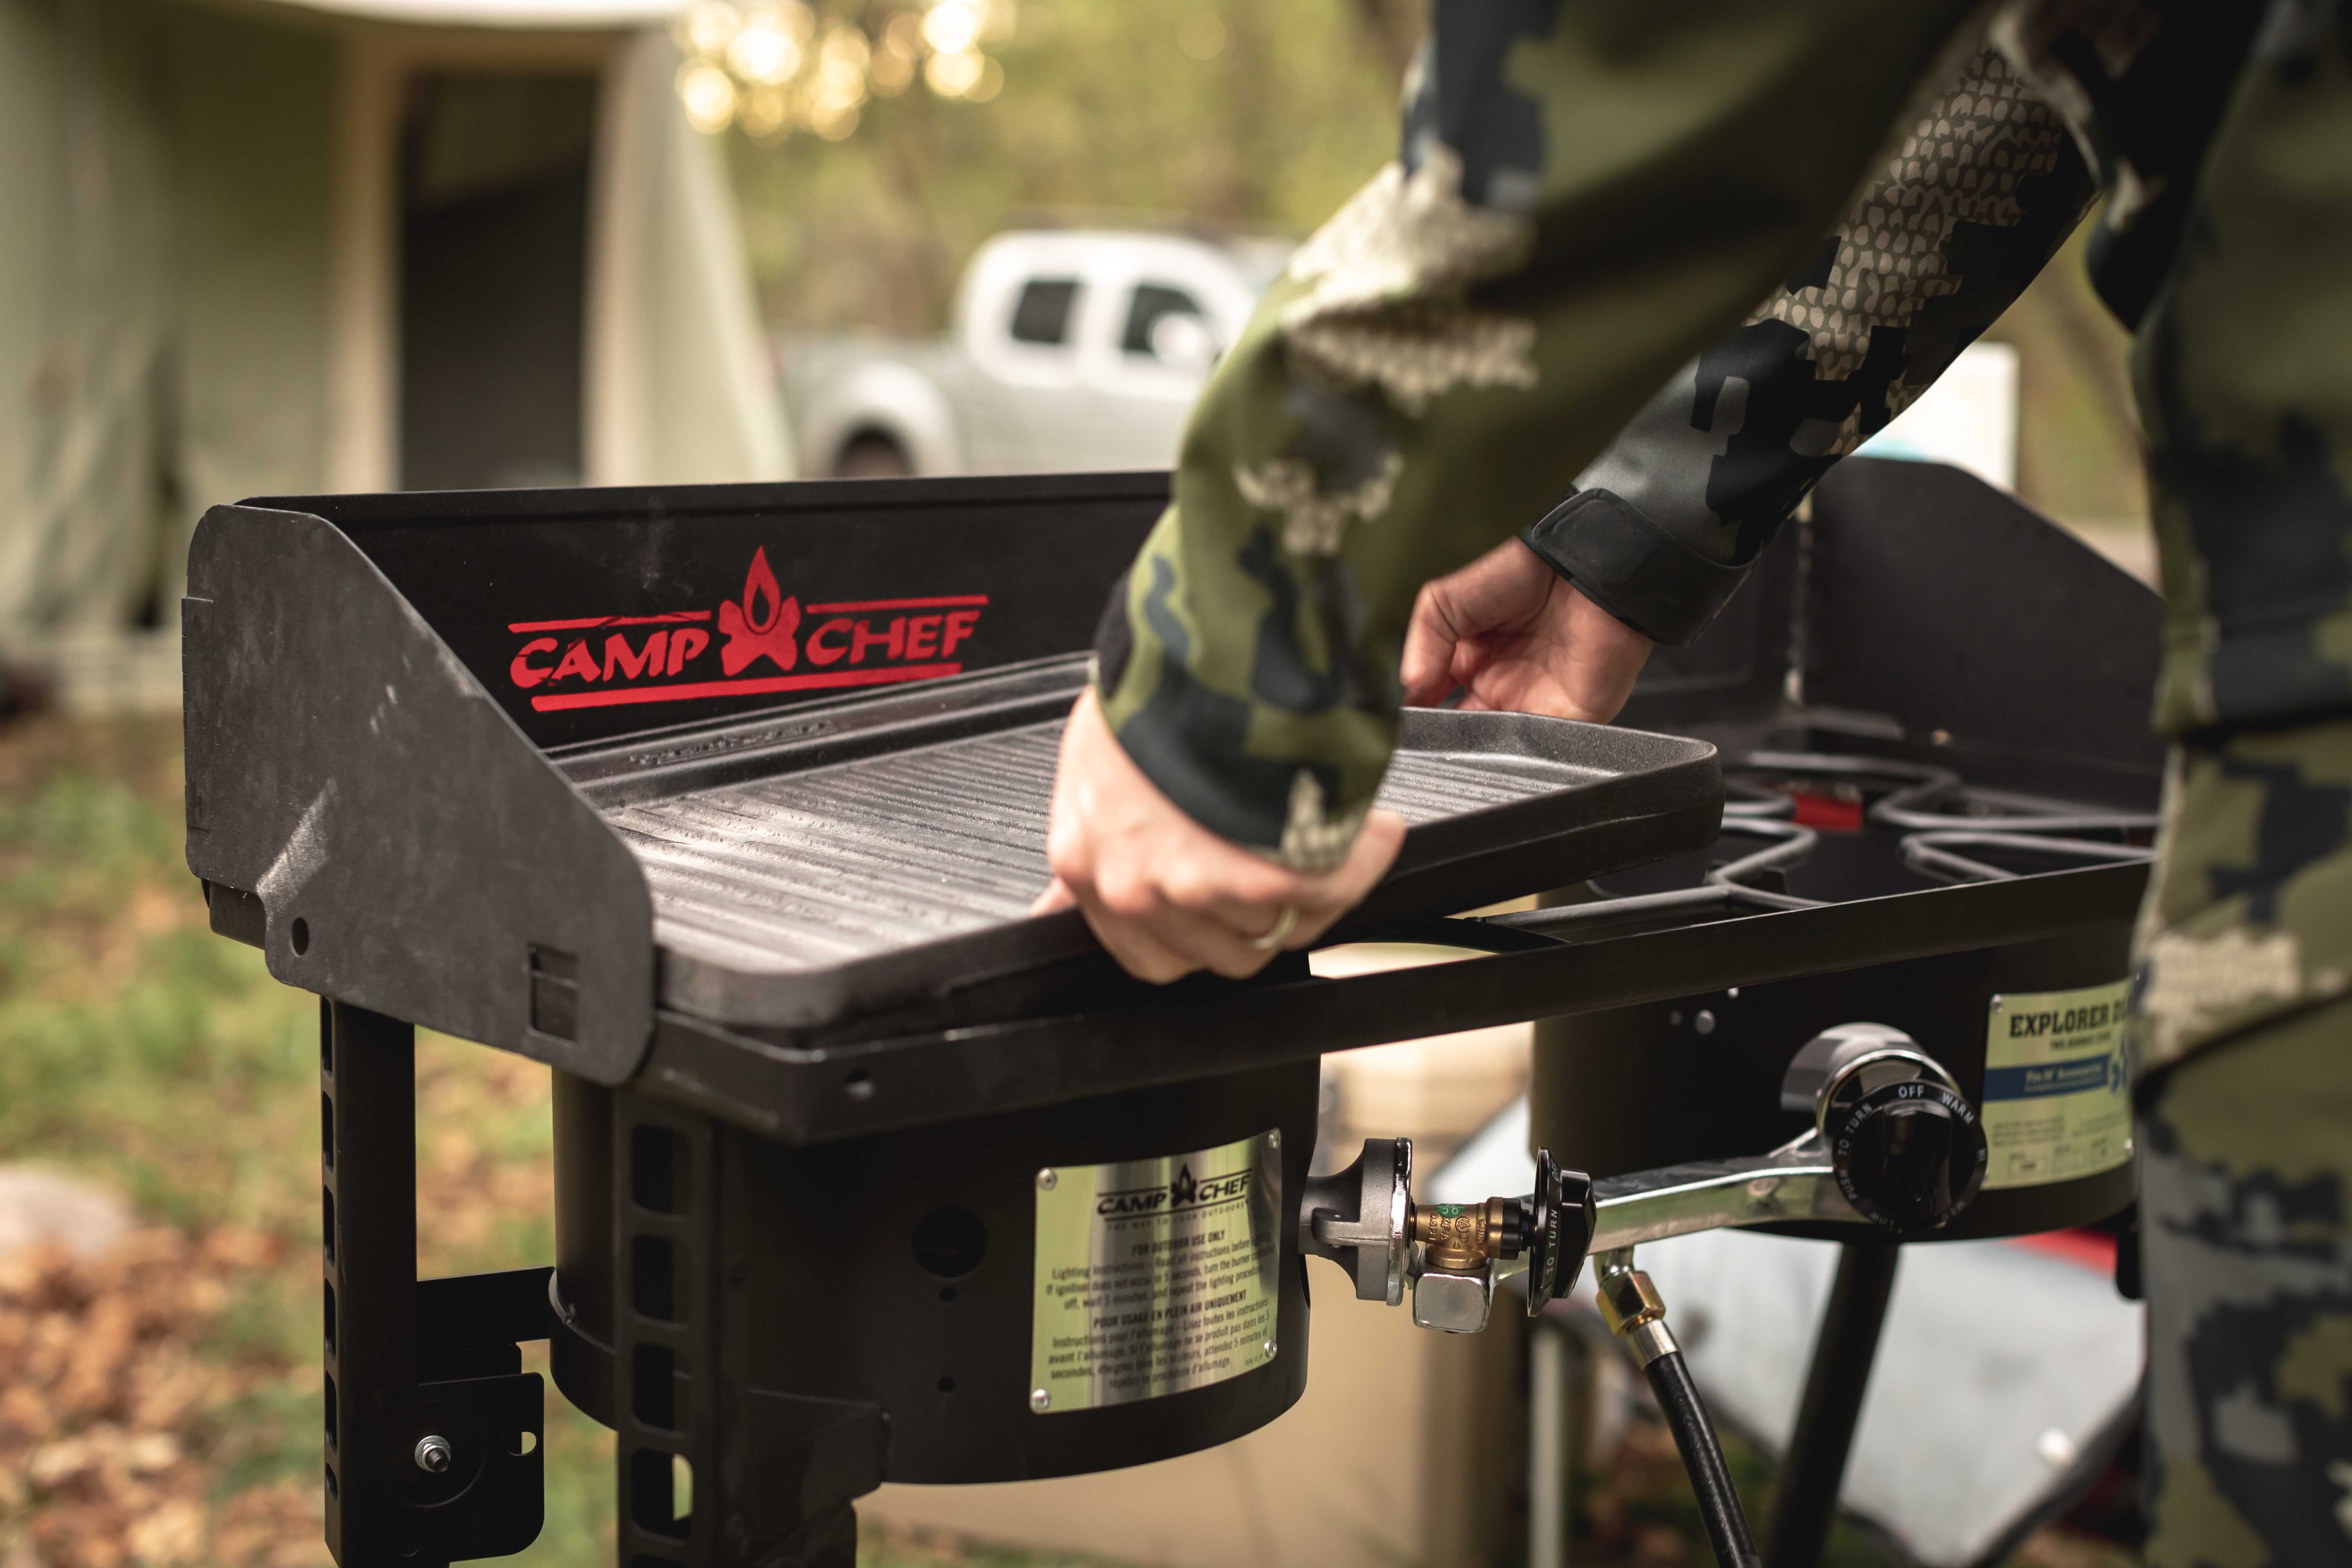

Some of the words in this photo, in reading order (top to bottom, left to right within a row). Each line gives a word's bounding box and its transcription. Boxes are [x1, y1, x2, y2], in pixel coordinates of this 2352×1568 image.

[510, 627, 710, 689] CAMP
[806, 610, 981, 666] CHEF
[2009, 1003, 2109, 1038] EXPLORER
[1898, 1085, 1924, 1099] OFF
[1942, 1091, 1974, 1125] WARM
[1845, 1103, 1874, 1134] TURN
[1838, 1139, 1850, 1156] TO
[1551, 1158, 1559, 1181] OFF
[1838, 1169, 1858, 1201] PUSH
[1097, 1192, 1168, 1215] CAMP
[1198, 1174, 1250, 1201] CHEF
[1132, 1244, 1150, 1255] FOR
[1152, 1237, 1190, 1252] OUTDOOR
[1192, 1234, 1205, 1245] USE
[1208, 1230, 1226, 1243] ONLY
[1549, 1210, 1558, 1248] TURN
[1052, 1268, 1091, 1280] Lighting
[1189, 1246, 1230, 1261] instructions
[1232, 1239, 1250, 1252] before
[1205, 1264, 1219, 1274] turn
[1220, 1261, 1231, 1269] the
[1232, 1255, 1250, 1267] burner
[1547, 1257, 1554, 1275] TO
[1083, 1297, 1102, 1307] wait
[1170, 1283, 1194, 1297] repeat
[1196, 1282, 1207, 1291] the
[1209, 1275, 1234, 1289] lighting
[1094, 1316, 1119, 1328] POUR
[1122, 1312, 1149, 1325] USAGE
[1152, 1310, 1163, 1320] EN
[1165, 1306, 1189, 1318] PLEIN
[1190, 1302, 1203, 1313] AIR
[1205, 1289, 1247, 1310] UNIQUEMENT
[1184, 1320, 1202, 1331] Lisez
[1204, 1314, 1224, 1326] toutes
[1227, 1310, 1235, 1320] les
[1237, 1299, 1269, 1316] instructions
[1048, 1353, 1075, 1364] avant
[1184, 1337, 1194, 1346] ne
[1205, 1326, 1229, 1342] produit
[1231, 1323, 1241, 1336] pas
[1243, 1318, 1256, 1331] dans
[1267, 1310, 1270, 1321] 5
[1137, 1359, 1154, 1370] tous
[1156, 1356, 1167, 1365] les
[1205, 1341, 1232, 1356] attendez
[1235, 1338, 1239, 1348] 5
[1240, 1331, 1261, 1346] minutes
[1262, 1326, 1267, 1337] et
